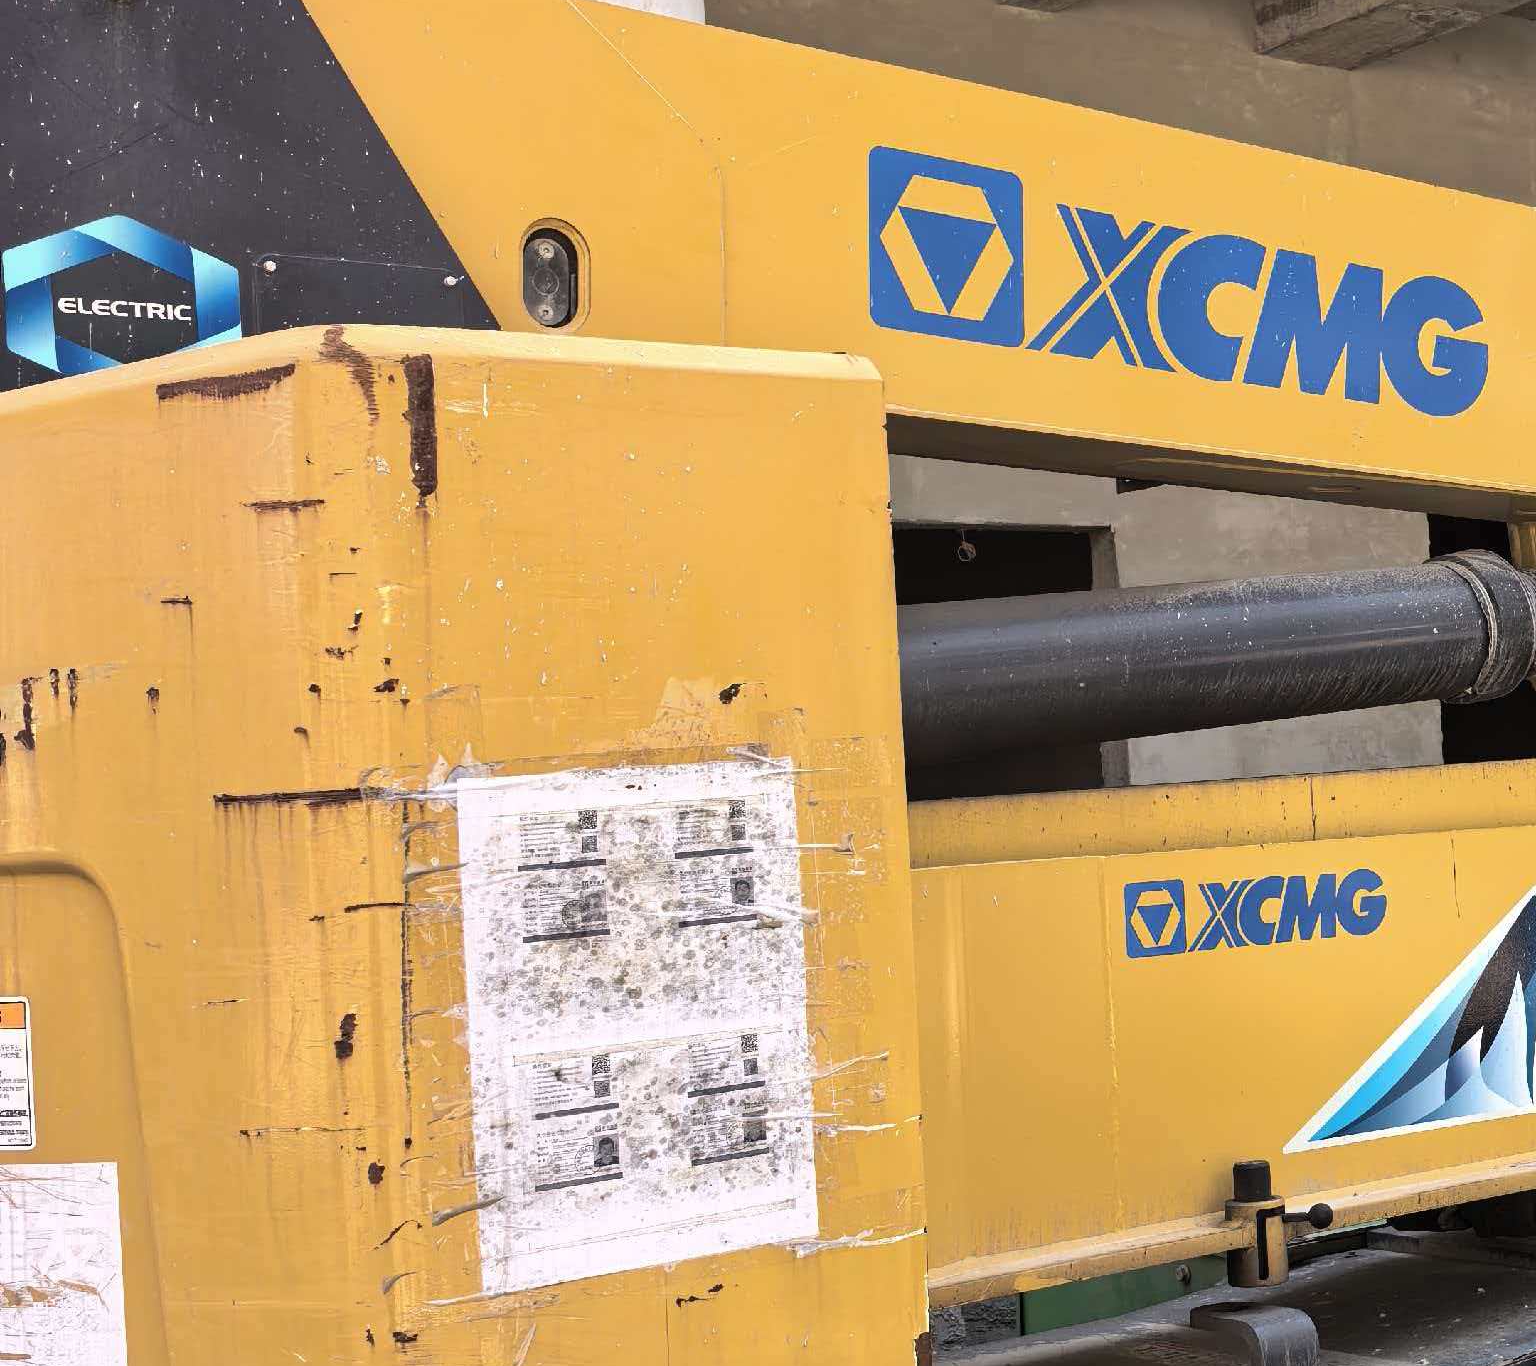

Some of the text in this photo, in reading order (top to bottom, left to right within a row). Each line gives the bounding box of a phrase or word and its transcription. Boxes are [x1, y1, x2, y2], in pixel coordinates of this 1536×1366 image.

[56, 295, 193, 323] ELECTRIC
[1025, 203, 1489, 418] XCMG
[1188, 867, 1388, 952] XCMG
